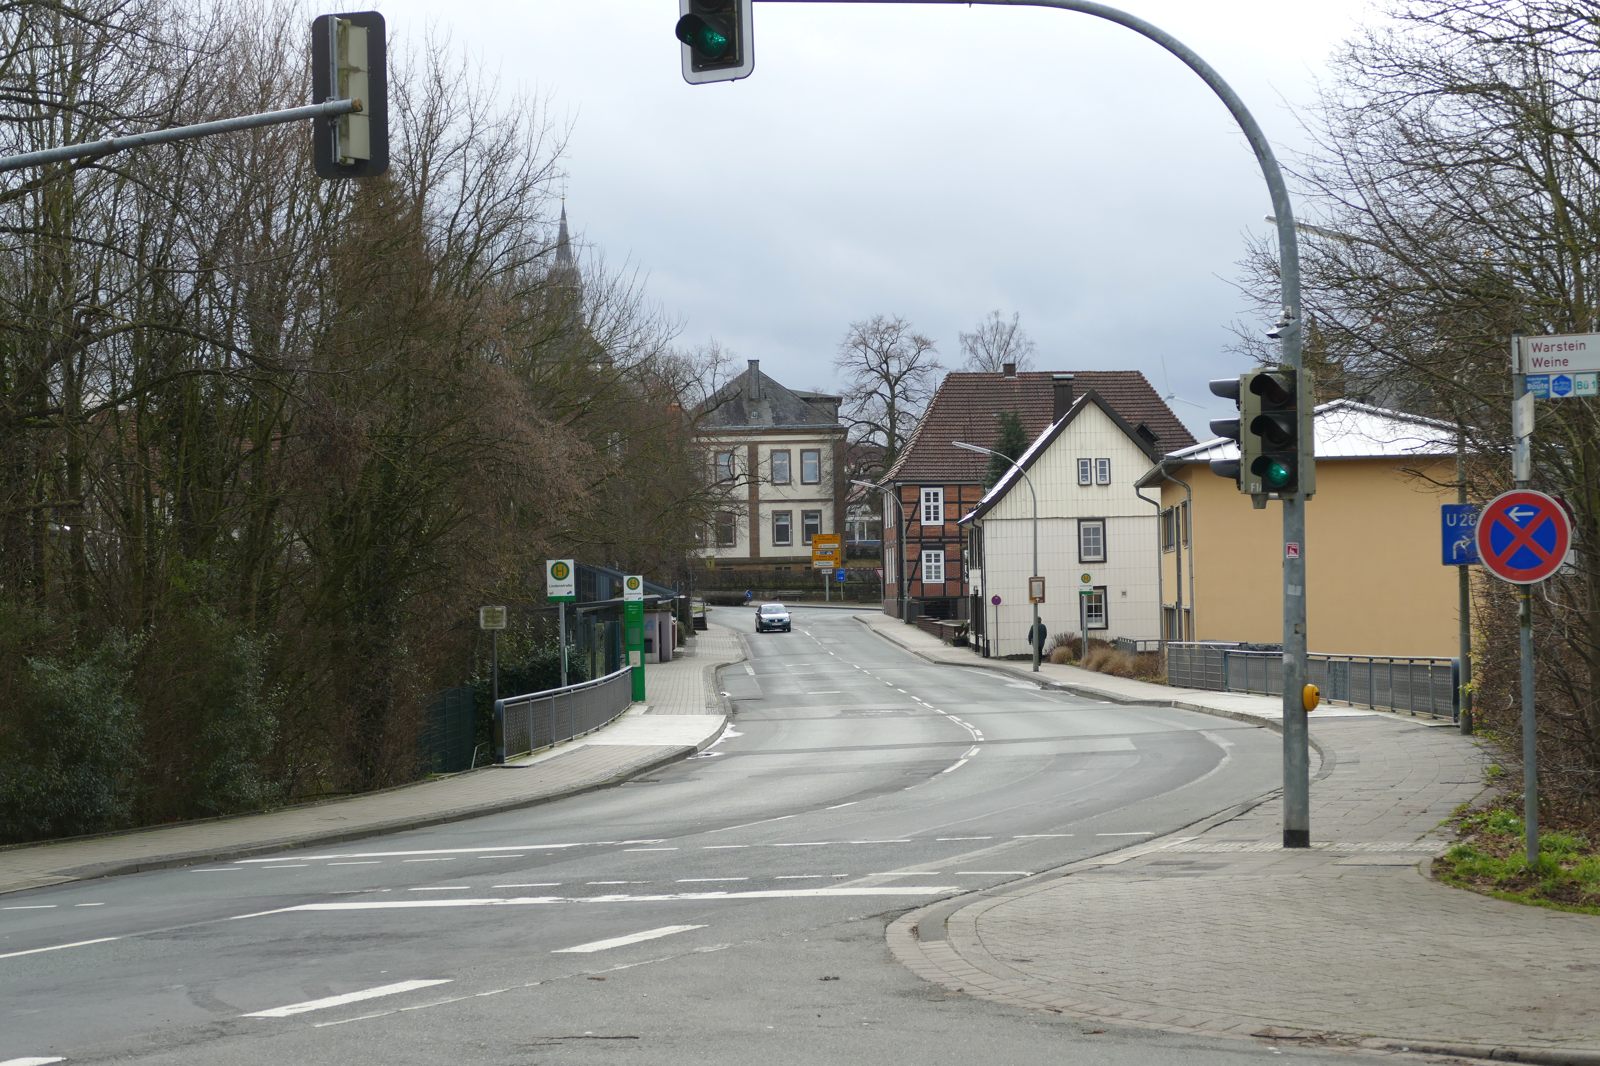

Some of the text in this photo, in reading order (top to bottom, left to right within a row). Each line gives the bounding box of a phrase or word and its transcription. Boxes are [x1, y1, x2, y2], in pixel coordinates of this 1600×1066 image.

[1531, 340, 1586, 353] Warstein
[1531, 357, 1569, 368] Weine
[1446, 513, 1457, 527] U
